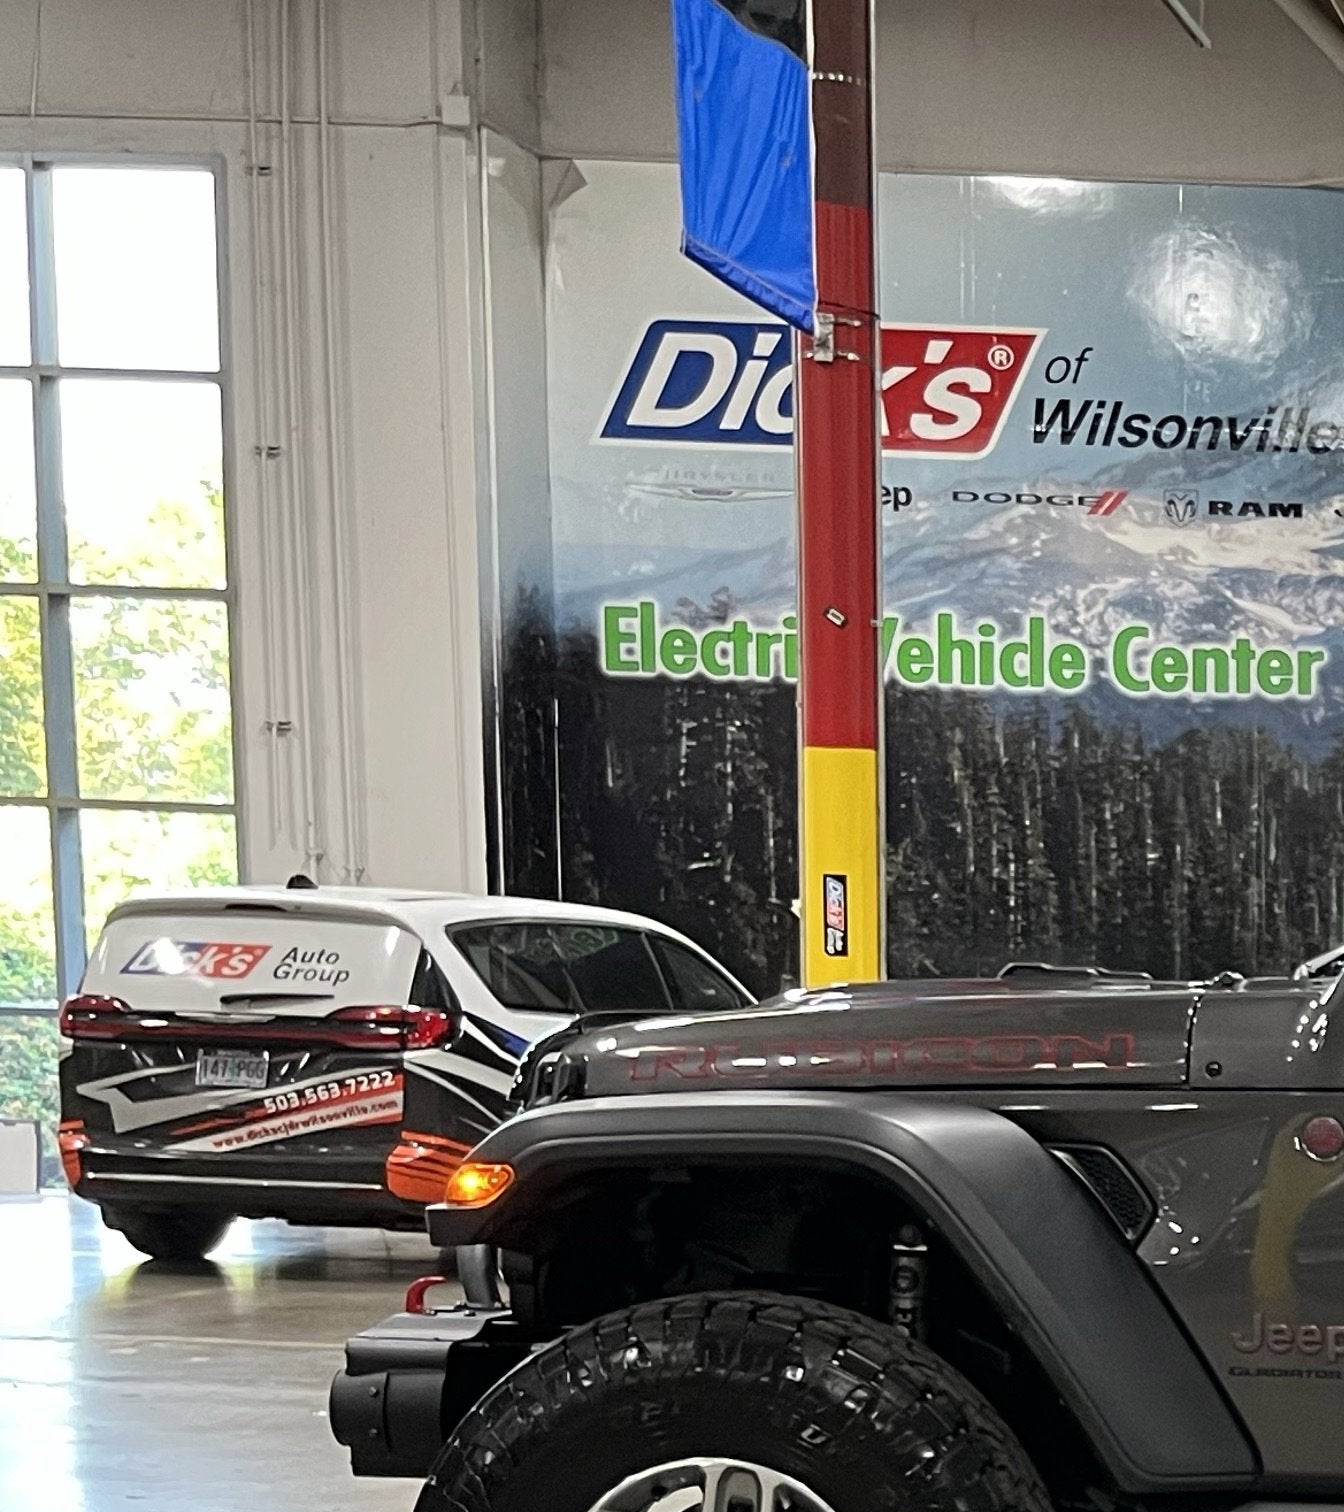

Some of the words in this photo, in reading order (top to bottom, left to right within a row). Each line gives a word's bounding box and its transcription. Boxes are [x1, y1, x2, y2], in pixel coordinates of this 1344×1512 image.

[1044, 347, 1094, 384] of
[1033, 396, 1339, 455] Wilsonville
[952, 491, 1098, 507] DODGE
[1208, 500, 1303, 518] RAM
[604, 601, 798, 677] Electri
[1112, 625, 1325, 695] Center
[280, 946, 341, 965] Auto
[273, 963, 350, 987] Group
[263, 1070, 397, 1114] 503.563.7222
